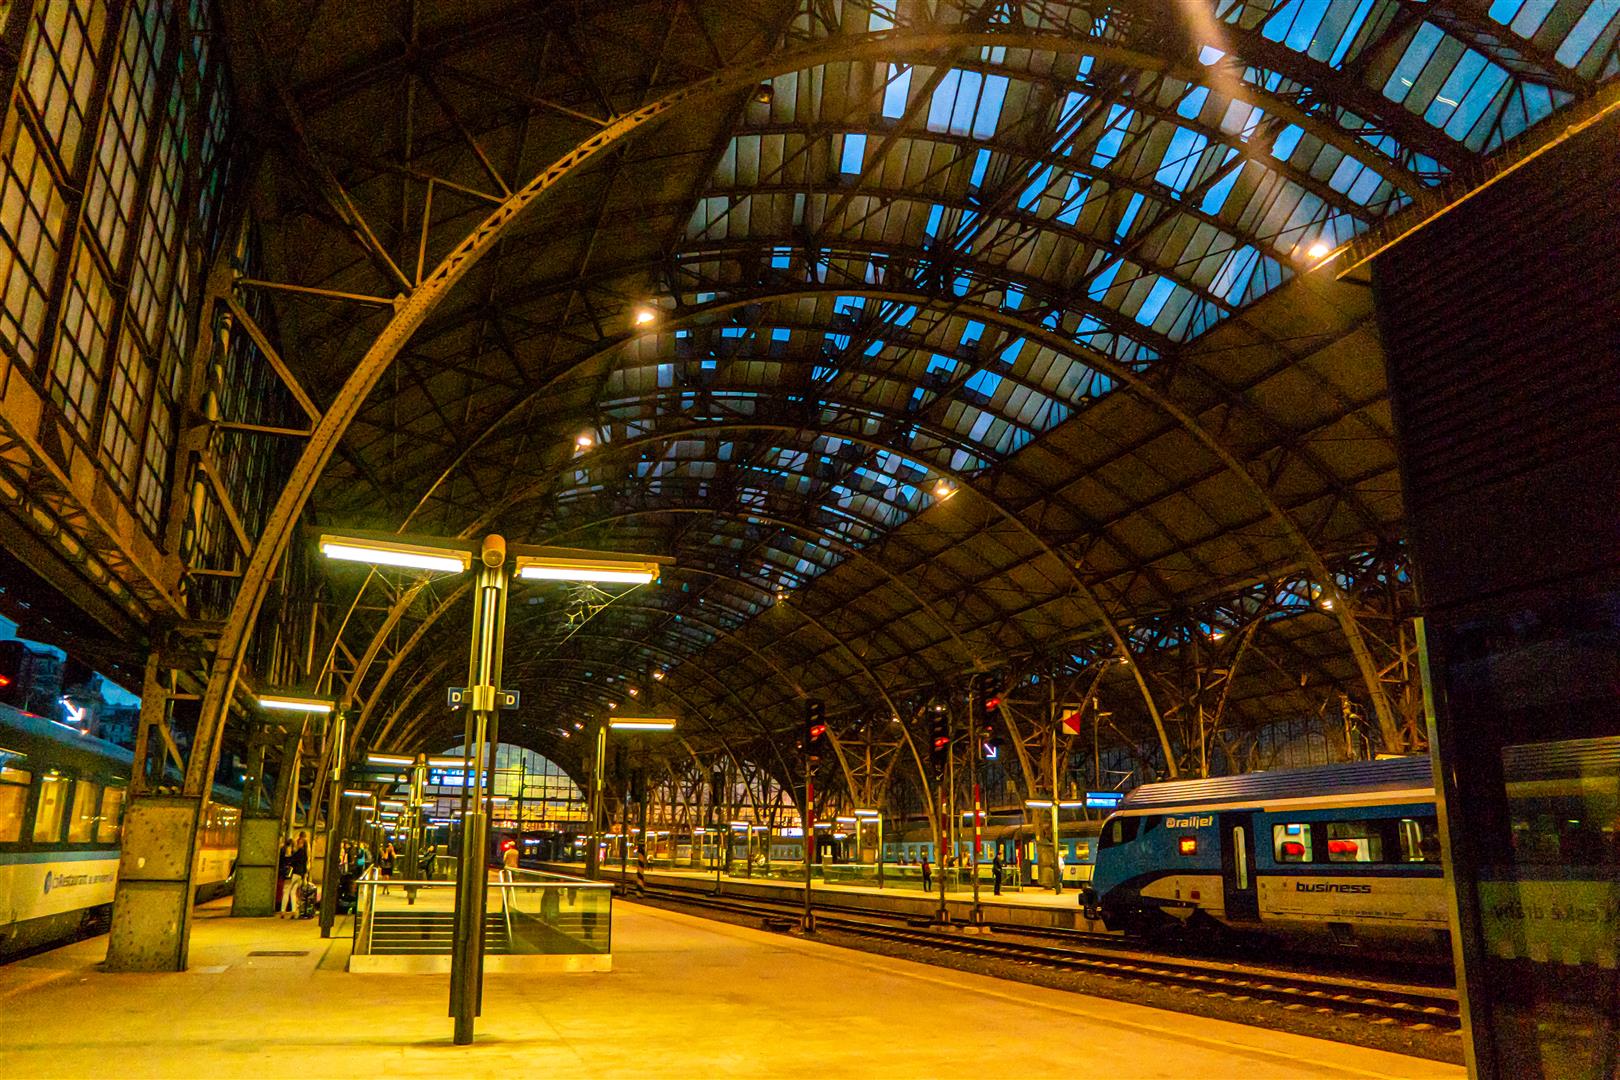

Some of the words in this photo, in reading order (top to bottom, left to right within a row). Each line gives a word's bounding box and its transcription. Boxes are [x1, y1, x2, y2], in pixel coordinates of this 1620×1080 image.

[452, 692, 461, 703] D
[506, 695, 515, 705] D
[1296, 882, 1372, 894] business
